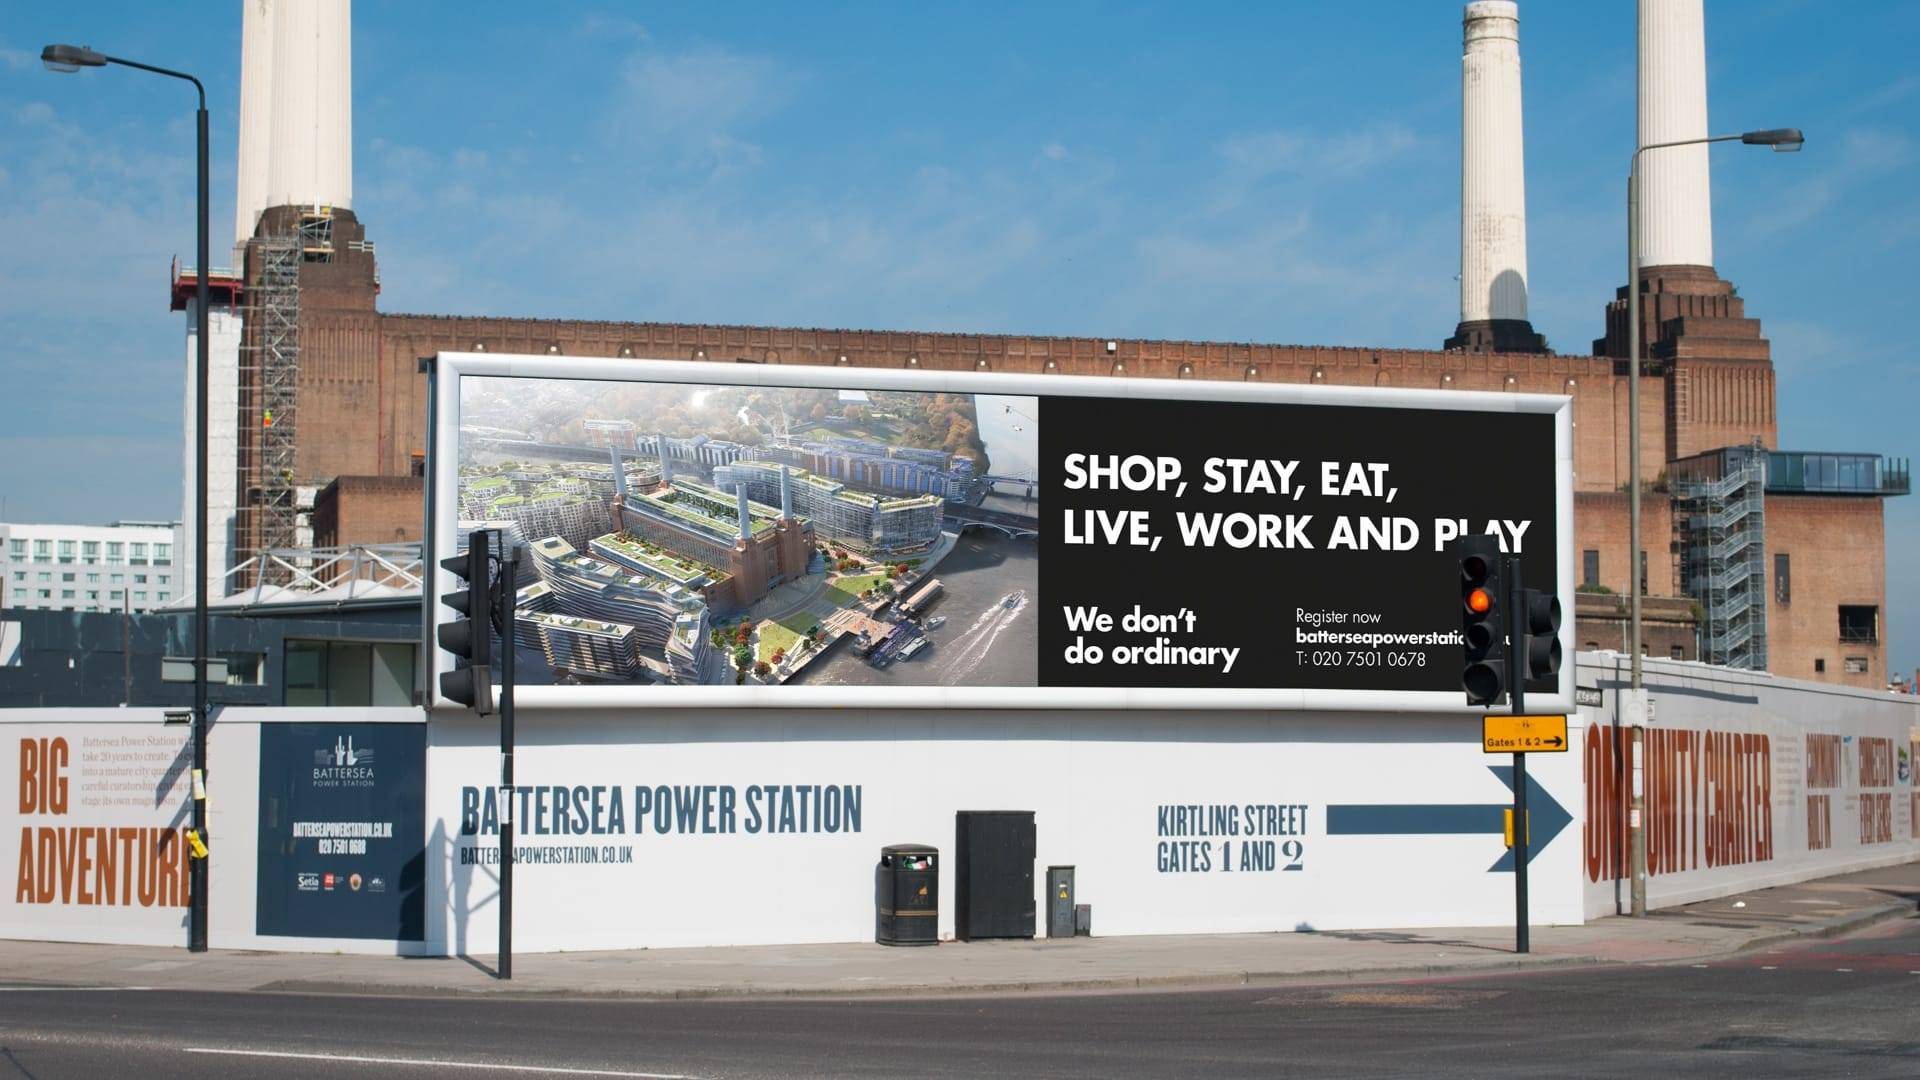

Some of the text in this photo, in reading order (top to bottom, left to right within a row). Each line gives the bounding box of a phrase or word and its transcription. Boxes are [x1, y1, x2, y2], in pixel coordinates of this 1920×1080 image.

[1063, 453, 1398, 503] SHOP, STAY, EAT,
[1064, 509, 1163, 552] LIVE,
[1176, 512, 1315, 549] WORK
[1327, 515, 1419, 551] AND
[1063, 605, 1197, 633] We don't
[1296, 607, 1382, 628] Register now
[1064, 636, 1241, 673] do ordinary
[1296, 651, 1426, 667] T: 020 7501 0678
[121, 735, 145, 746] Power
[147, 735, 176, 746] Station
[1487, 737, 1541, 747] Gates 1 & 2
[19, 736, 69, 815] BIG
[313, 768, 374, 779] BATTERSEA
[462, 784, 862, 835] BATERSEA POWER STATION
[1704, 729, 1774, 868] CHARTER
[1157, 804, 1308, 836] KIRTLING STREET
[461, 846, 632, 865] BATTERAPOWERSTATION.CO.UK
[1157, 840, 1304, 873] GATES 1 AND 2
